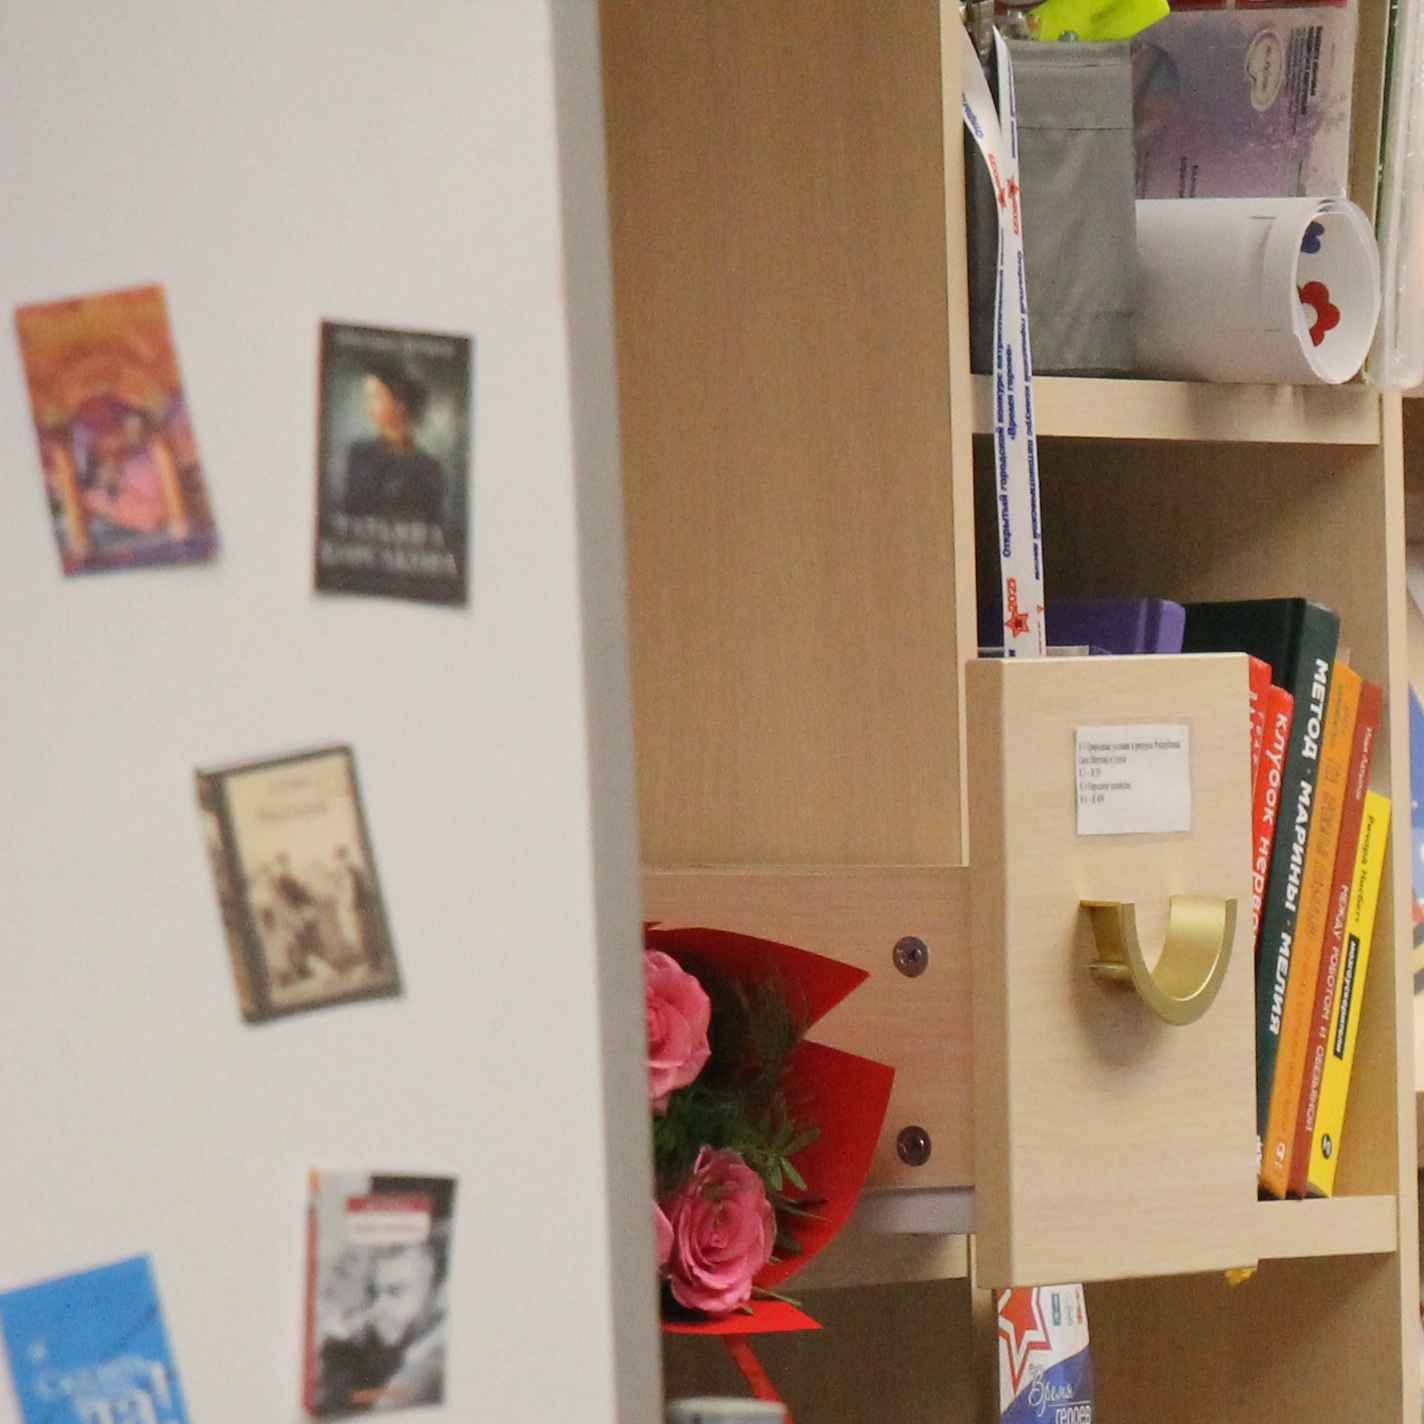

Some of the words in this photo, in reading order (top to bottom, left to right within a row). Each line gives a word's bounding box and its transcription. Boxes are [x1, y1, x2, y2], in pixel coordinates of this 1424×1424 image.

[1302, 658, 1329, 760] МЕТОД
[1263, 713, 1289, 824] клубок
[1285, 780, 1313, 912] МАРИНЫ
[1361, 815, 1375, 865] Ричард
[1333, 884, 1349, 940] МЕЖДУ
[1269, 932, 1293, 1035] МЕЛИЯ
[1321, 946, 1340, 1020] РОБОТОМ
[1305, 1045, 1324, 1132] ОБЕЗЬЯНОЙ
